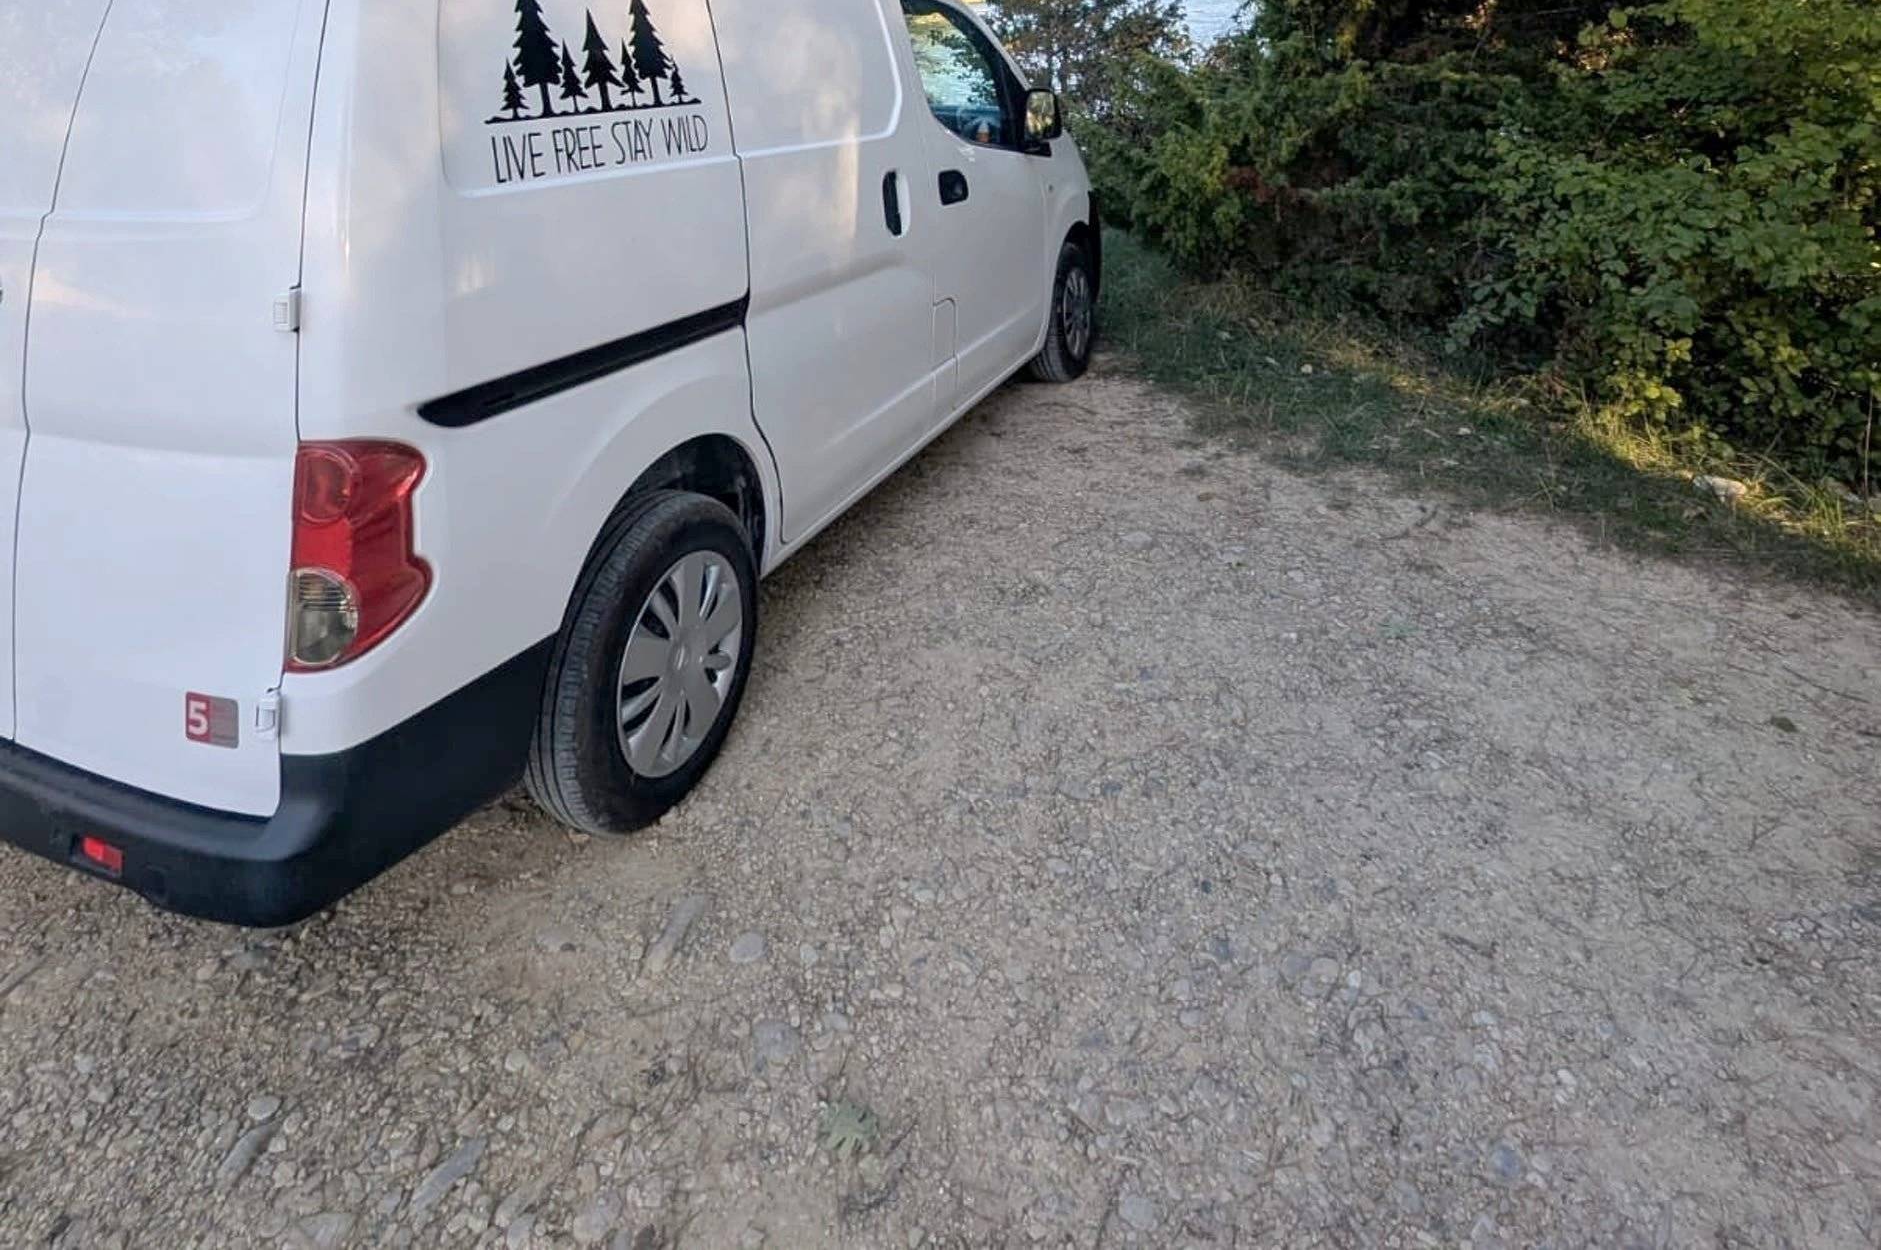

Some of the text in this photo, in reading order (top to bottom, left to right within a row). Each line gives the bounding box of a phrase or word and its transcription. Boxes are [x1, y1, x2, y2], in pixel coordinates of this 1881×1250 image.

[491, 115, 709, 183] LIVE FREE STAY WILD
[188, 700, 208, 735] 5
